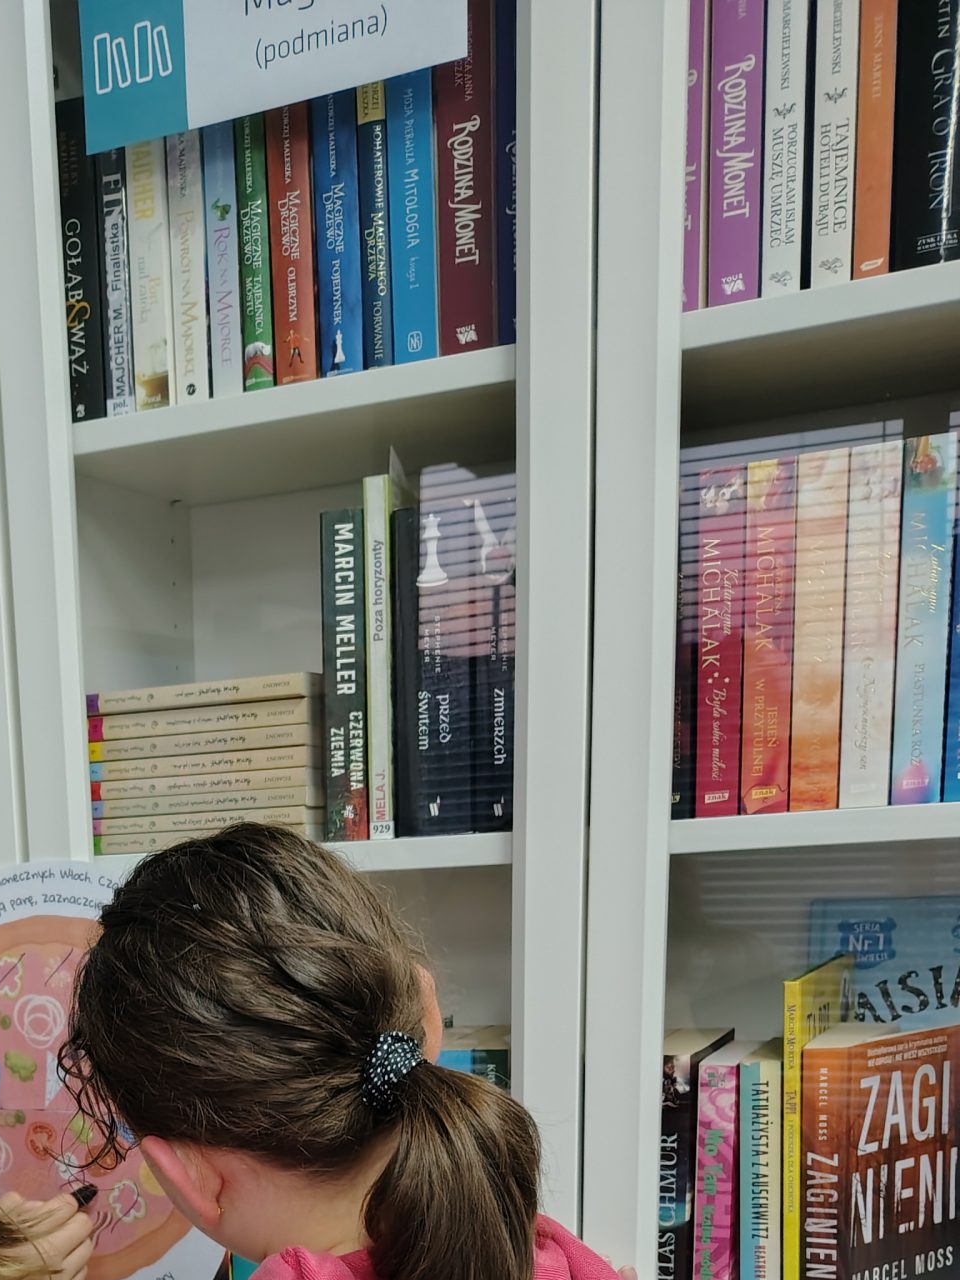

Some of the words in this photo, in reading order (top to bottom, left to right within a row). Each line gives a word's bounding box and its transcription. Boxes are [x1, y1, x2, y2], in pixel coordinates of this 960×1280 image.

[254, 5, 388, 70] (podmiana)
[405, 88, 413, 115] MOJA
[717, 53, 755, 151] RODZINA
[283, 138, 292, 184] MALESZKA
[329, 131, 337, 177] MALESZKA
[372, 125, 385, 211] BOHATEROWIE
[405, 117, 415, 166] PIERWSZA
[447, 114, 481, 203] RODZINA
[769, 126, 785, 181] MUSZĘ
[819, 122, 832, 179] HOTELI
[177, 147, 188, 200] MAJEWSKA
[245, 148, 254, 194] MALESZKA
[716, 148, 755, 219] MONET
[831, 117, 850, 233] TAJEMNICE
[240, 208, 253, 266] DRZEWO
[248, 200, 263, 270] MAGICZNE
[278, 199, 291, 257] DRZEWO
[286, 190, 300, 260] MAGICZNE
[322, 192, 335, 250] DRZEWO
[331, 182, 345, 254] MAGICZNE
[403, 168, 420, 249] MITOLOGIA
[447, 200, 482, 265] MONET
[815, 182, 831, 237] DUBAJU
[111, 222, 123, 292] Finalistka
[180, 210, 195, 275] POWRÓT
[213, 226, 231, 263] ROK
[364, 226, 375, 281] DRZEWA
[370, 211, 387, 297] MAGICZNEGO
[113, 302, 123, 318] M.
[244, 277, 255, 316] MOSTU
[254, 274, 264, 335] TAJEMNICA
[287, 266, 298, 322] OLBRZYM
[331, 258, 342, 325] POJEDYNEK
[214, 289, 234, 367] MAJORCE
[373, 301, 384, 361] PORWANIE
[112, 322, 128, 397] MAJCHER
[334, 522, 355, 606] MARCIN
[372, 539, 387, 605] horyzonty
[754, 526, 776, 653] MICHALAK
[372, 607, 384, 642] Poza
[700, 537, 722, 670] MICHALAK
[722, 567, 741, 637] Katarzyna
[335, 615, 356, 696] MELLER
[712, 686, 728, 718] Była
[754, 678, 766, 693] W
[417, 690, 430, 752] świtem
[439, 693, 450, 744] przed
[493, 687, 506, 766] zmierzch
[712, 719, 727, 746] sobie
[750, 695, 767, 777] PRZYTULNEJ
[765, 704, 779, 748] JESIEŃ
[330, 727, 345, 778] ZIEMIA
[349, 711, 364, 791] CZERWONA
[375, 769, 386, 780] J.
[711, 747, 728, 782] miłość
[373, 824, 391, 834] 929
[375, 784, 386, 821] MELA
[848, 933, 873, 952] Nr
[876, 933, 885, 951] 1
[853, 922, 880, 934] SERIA
[817, 1067, 829, 1107] MARCEL
[856, 1060, 952, 1157] ZAGI
[703, 1128, 725, 1157] Mo
[751, 1080, 774, 1157] TATUAŻYSTA
[817, 1113, 828, 1141] MOSS
[657, 1132, 679, 1228] CHMUR
[701, 1163, 724, 1197] Yan
[751, 1161, 768, 1170] Z
[751, 1173, 769, 1240] AUSCHWITZ
[850, 1146, 960, 1248] NIENI
[754, 1244, 767, 1279] HEATHER
[915, 1245, 953, 1275] MOSS
